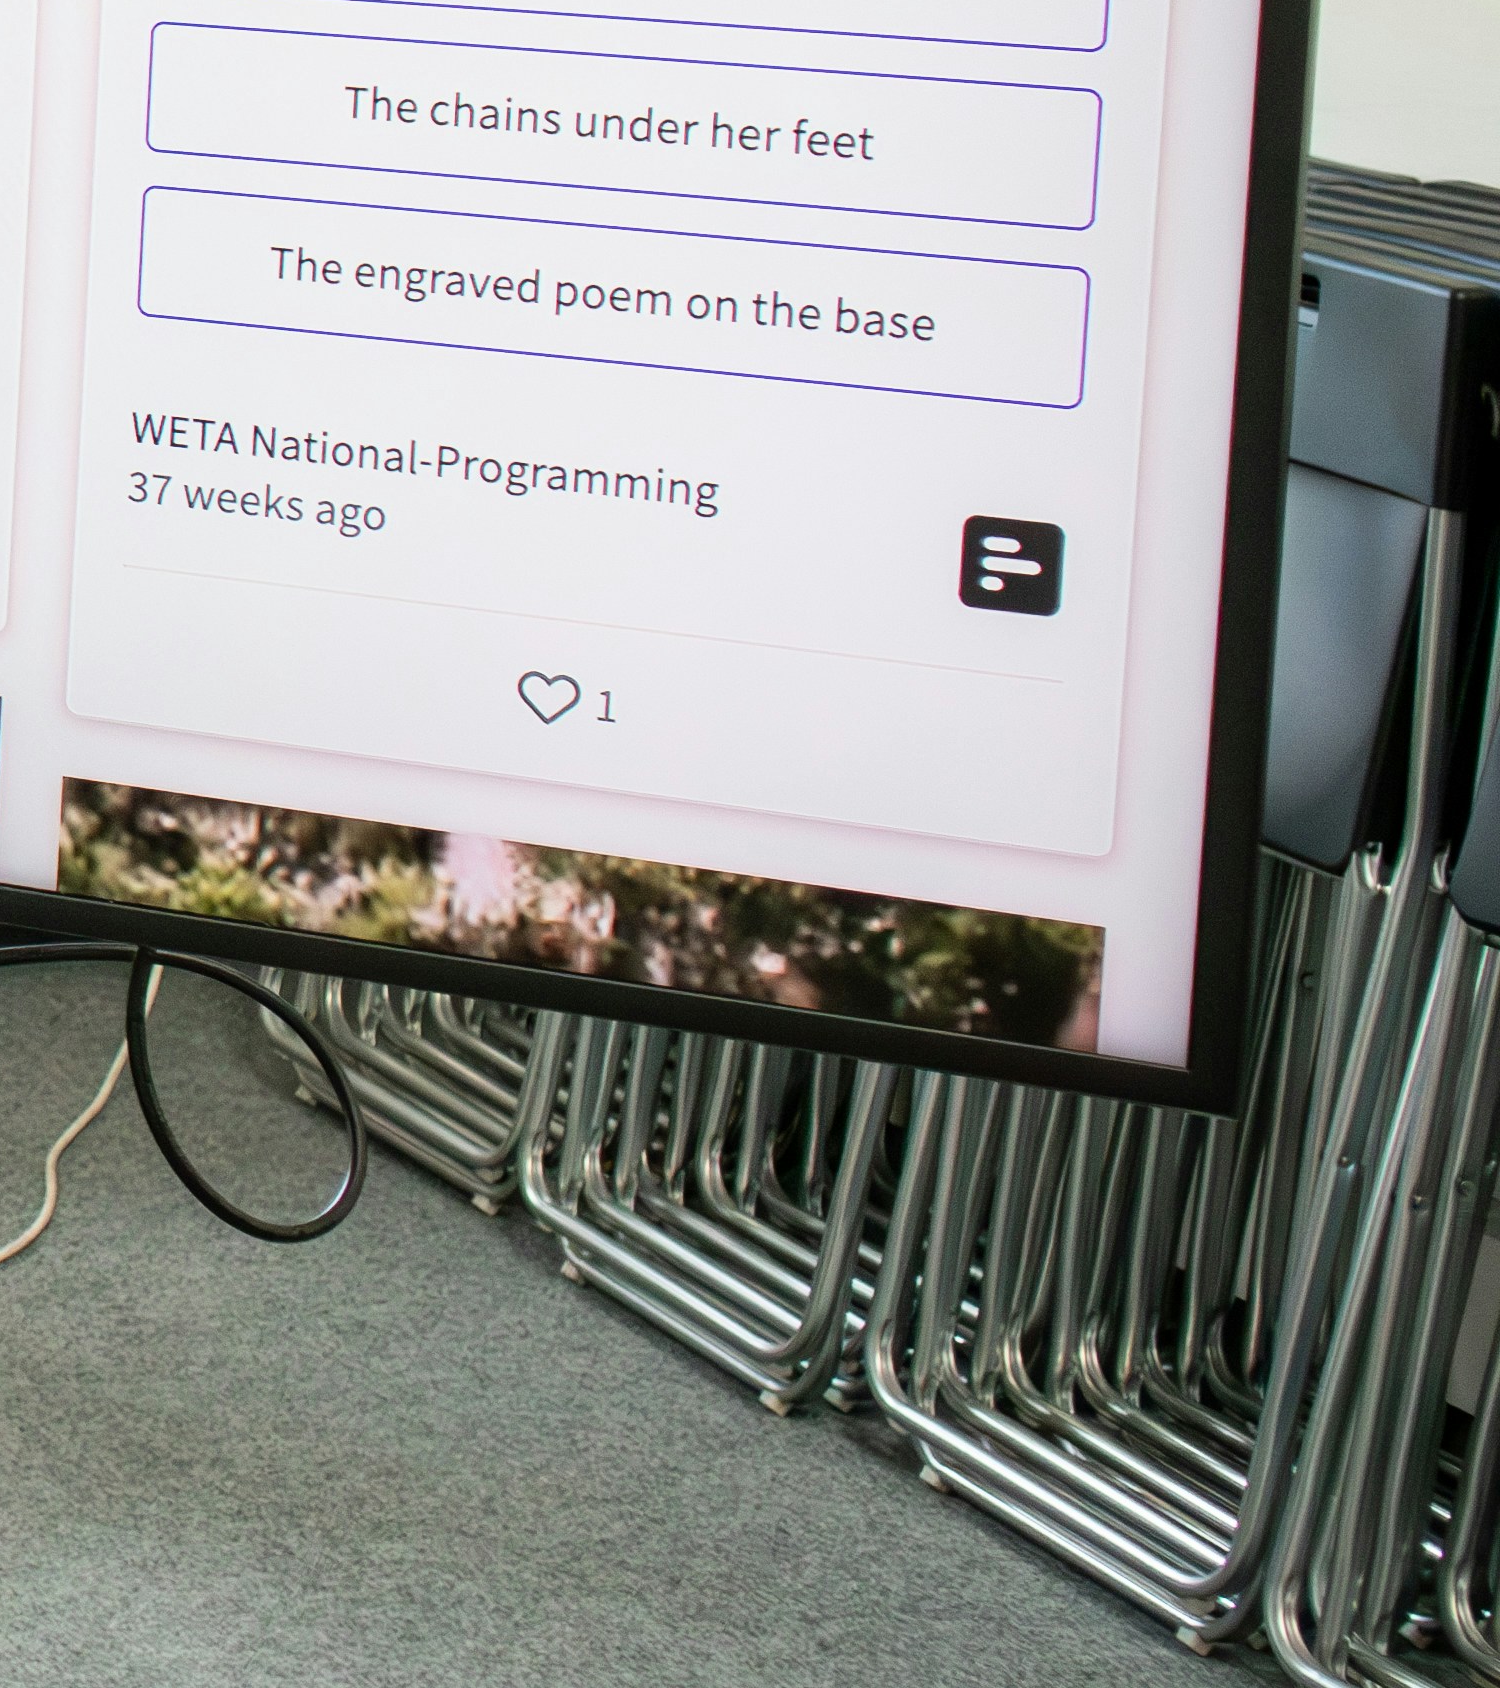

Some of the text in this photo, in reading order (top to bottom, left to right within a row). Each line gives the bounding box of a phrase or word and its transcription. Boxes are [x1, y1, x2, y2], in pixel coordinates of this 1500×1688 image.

[132, 411, 720, 518] WETA National-Programming
[127, 471, 386, 538] 37 weeks ago
[596, 690, 616, 723] 1
